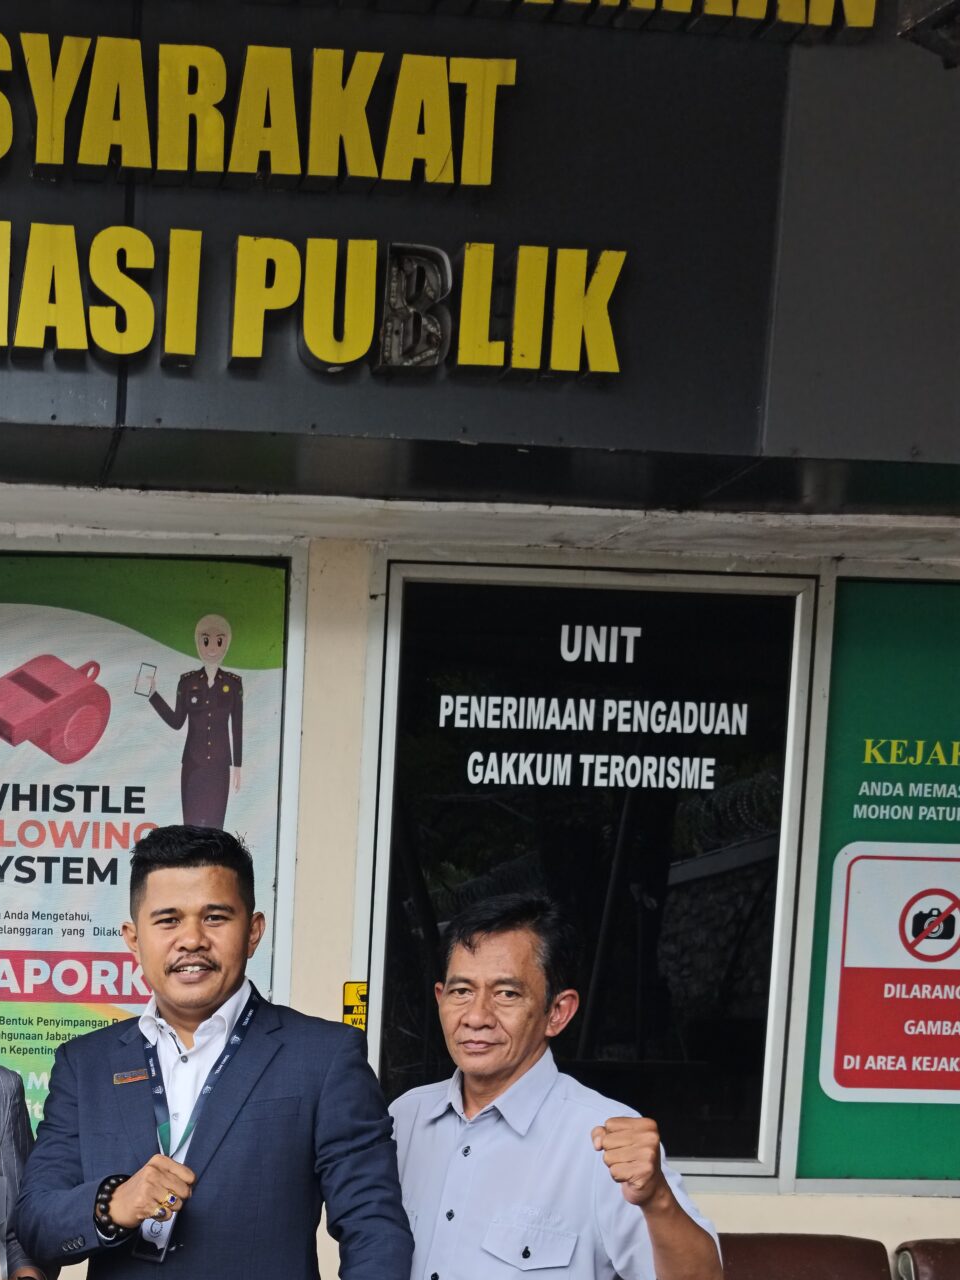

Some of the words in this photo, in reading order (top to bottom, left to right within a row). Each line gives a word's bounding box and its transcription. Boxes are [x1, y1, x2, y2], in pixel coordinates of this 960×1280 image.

[230, 234, 628, 374] PUBLIK
[560, 624, 641, 663] UNIT
[439, 695, 595, 730] PENERIMAAN
[602, 699, 748, 736] PENGADUAN
[467, 751, 572, 786] GAKKUM
[580, 754, 716, 790] TERORISME
[858, 781, 904, 797] ANDA
[909, 783, 960, 798] MEMA
[853, 804, 913, 820] MOHON
[4, 911, 29, 920] Anda
[32, 911, 92, 922] Mengetahui,
[62, 928, 85, 937] yang
[0, 1016, 34, 1026] Bentuk
[37, 1017, 109, 1028] Penyimpangan
[843, 1055, 860, 1070] DI
[864, 1056, 907, 1071] AREA
